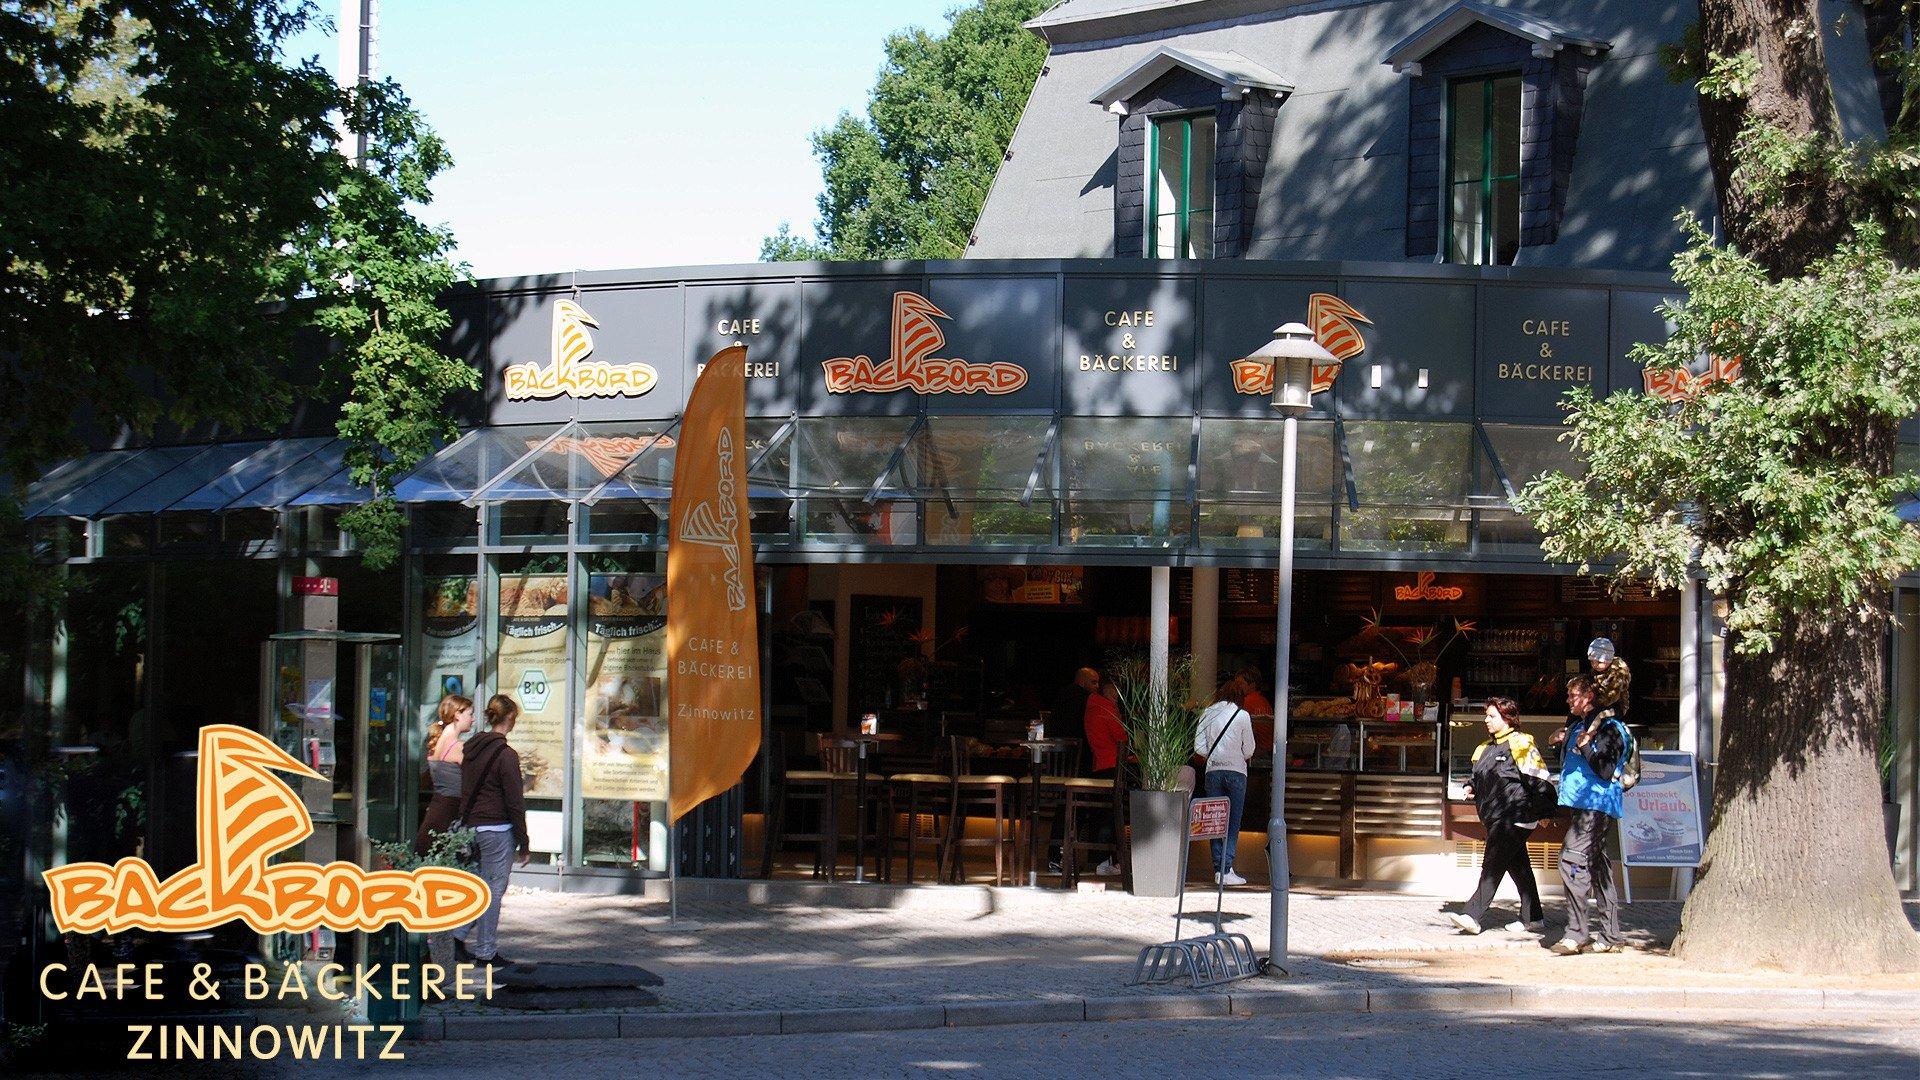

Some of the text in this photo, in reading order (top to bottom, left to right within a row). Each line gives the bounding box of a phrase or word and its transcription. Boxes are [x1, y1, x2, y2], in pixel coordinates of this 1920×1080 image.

[717, 318, 761, 336] CAFE
[1104, 309, 1155, 328] CAFE
[1522, 319, 1571, 338] CAFE
[1121, 332, 1137, 349] &
[1538, 342, 1554, 359] &
[1078, 351, 1179, 373] BÄCKEREI
[1498, 361, 1592, 382] BÄCKEREI
[505, 623, 534, 638] Täglich
[594, 622, 627, 638] Täglich
[688, 637, 739, 656] CAFE &
[677, 659, 754, 680] BÄCKEREI
[523, 681, 546, 695] BIO
[677, 704, 756, 721] Zinnowitz
[1638, 799, 1692, 813] Urlaub.
